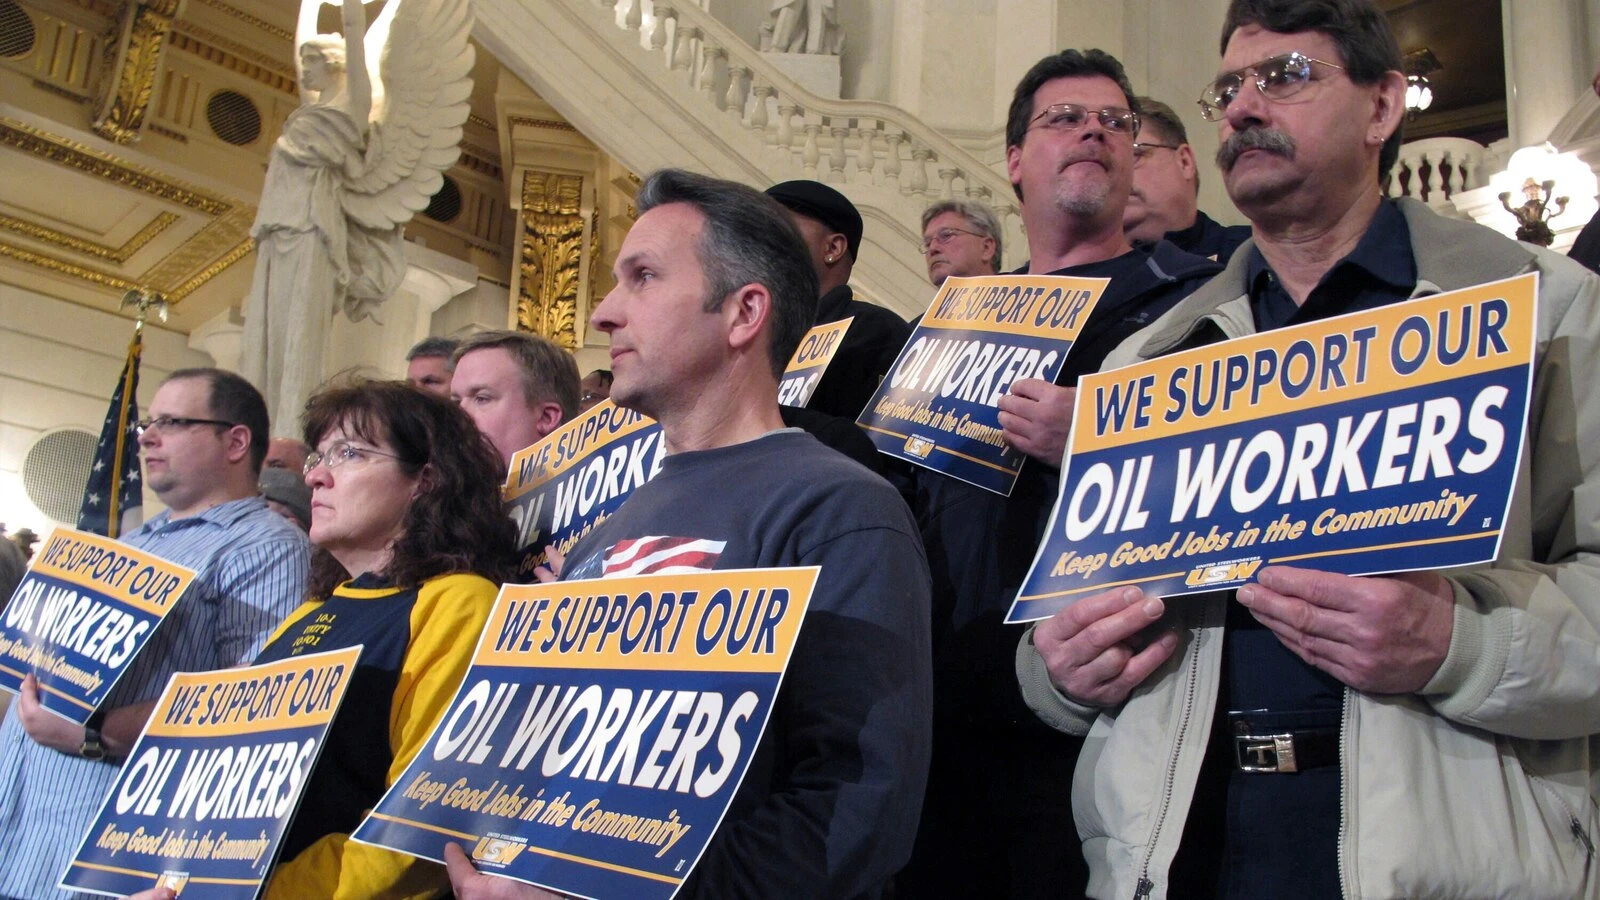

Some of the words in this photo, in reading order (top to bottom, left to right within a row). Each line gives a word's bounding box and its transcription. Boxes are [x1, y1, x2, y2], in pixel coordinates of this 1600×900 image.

[934, 287, 964, 319] WE
[957, 285, 1045, 324] SUPPORT
[1034, 287, 1091, 330] OUR
[797, 329, 840, 364] OUR
[890, 336, 940, 390] OIL
[1095, 379, 1154, 437] WE
[1162, 326, 1377, 424] SUPPORT
[1390, 298, 1510, 376] OUR
[873, 395, 894, 421] Keep
[891, 398, 920, 423] Good
[910, 399, 935, 426] Jobs
[930, 405, 944, 428] in
[939, 408, 958, 433] the
[956, 413, 1010, 457] Commun
[518, 441, 552, 488] WE
[551, 429, 668, 535] WORKE
[1065, 454, 1154, 543] OIL
[1170, 385, 1510, 524] WORKERS
[1050, 551, 1108, 579] Keep
[1109, 531, 1181, 568] Good
[1172, 525, 1234, 558] Jobs
[1231, 520, 1261, 548] in
[1261, 513, 1307, 544] the
[1311, 488, 1478, 536] Community
[43, 536, 71, 569] WE
[60, 541, 139, 588] SUPPORT
[128, 566, 181, 606] OUR
[1185, 559, 1263, 586] USW
[5, 577, 49, 633] OIL
[35, 585, 150, 670] WORKERS
[494, 598, 550, 653] WE
[540, 590, 697, 655] SUPPORT
[694, 587, 790, 656] OUR
[52, 655, 104, 697] Community
[164, 684, 208, 727] WE
[197, 672, 297, 727] SUPPORT
[287, 664, 345, 718] OUR
[433, 679, 507, 766] OIL
[499, 683, 760, 799] WORKERS
[115, 746, 182, 819] OIL
[166, 737, 317, 823] WORKERS
[95, 822, 130, 858] Keep
[126, 825, 169, 857] Good
[157, 827, 189, 860] Jobs
[183, 832, 200, 860] in
[193, 829, 213, 861] the
[210, 829, 271, 870] Community
[402, 771, 448, 811] Keep
[441, 776, 500, 812] Good
[481, 783, 529, 819] Jobs
[519, 788, 546, 822] in
[537, 791, 577, 828] the
[571, 798, 691, 859] Community
[471, 836, 528, 866] USW
